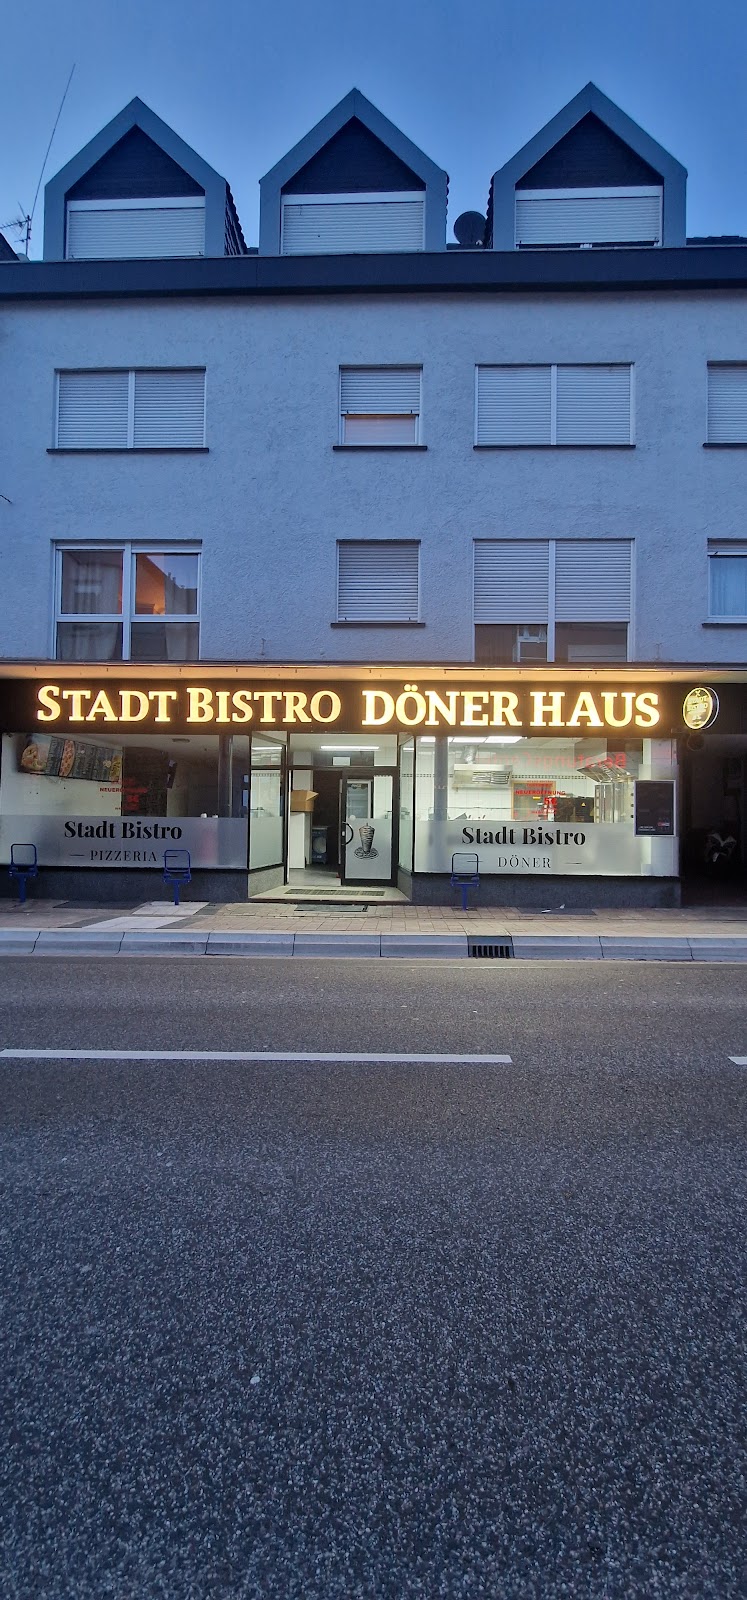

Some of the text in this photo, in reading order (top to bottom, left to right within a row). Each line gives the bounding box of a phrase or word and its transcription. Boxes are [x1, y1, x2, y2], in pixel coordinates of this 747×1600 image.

[36, 684, 660, 728] STADT BISTRO DÖNER HAUS
[64, 821, 183, 840] Stadt Bistro
[461, 826, 586, 846] Stadt Bistro
[90, 850, 157, 862] PIZZERIA
[498, 854, 552, 868] DÖNER
